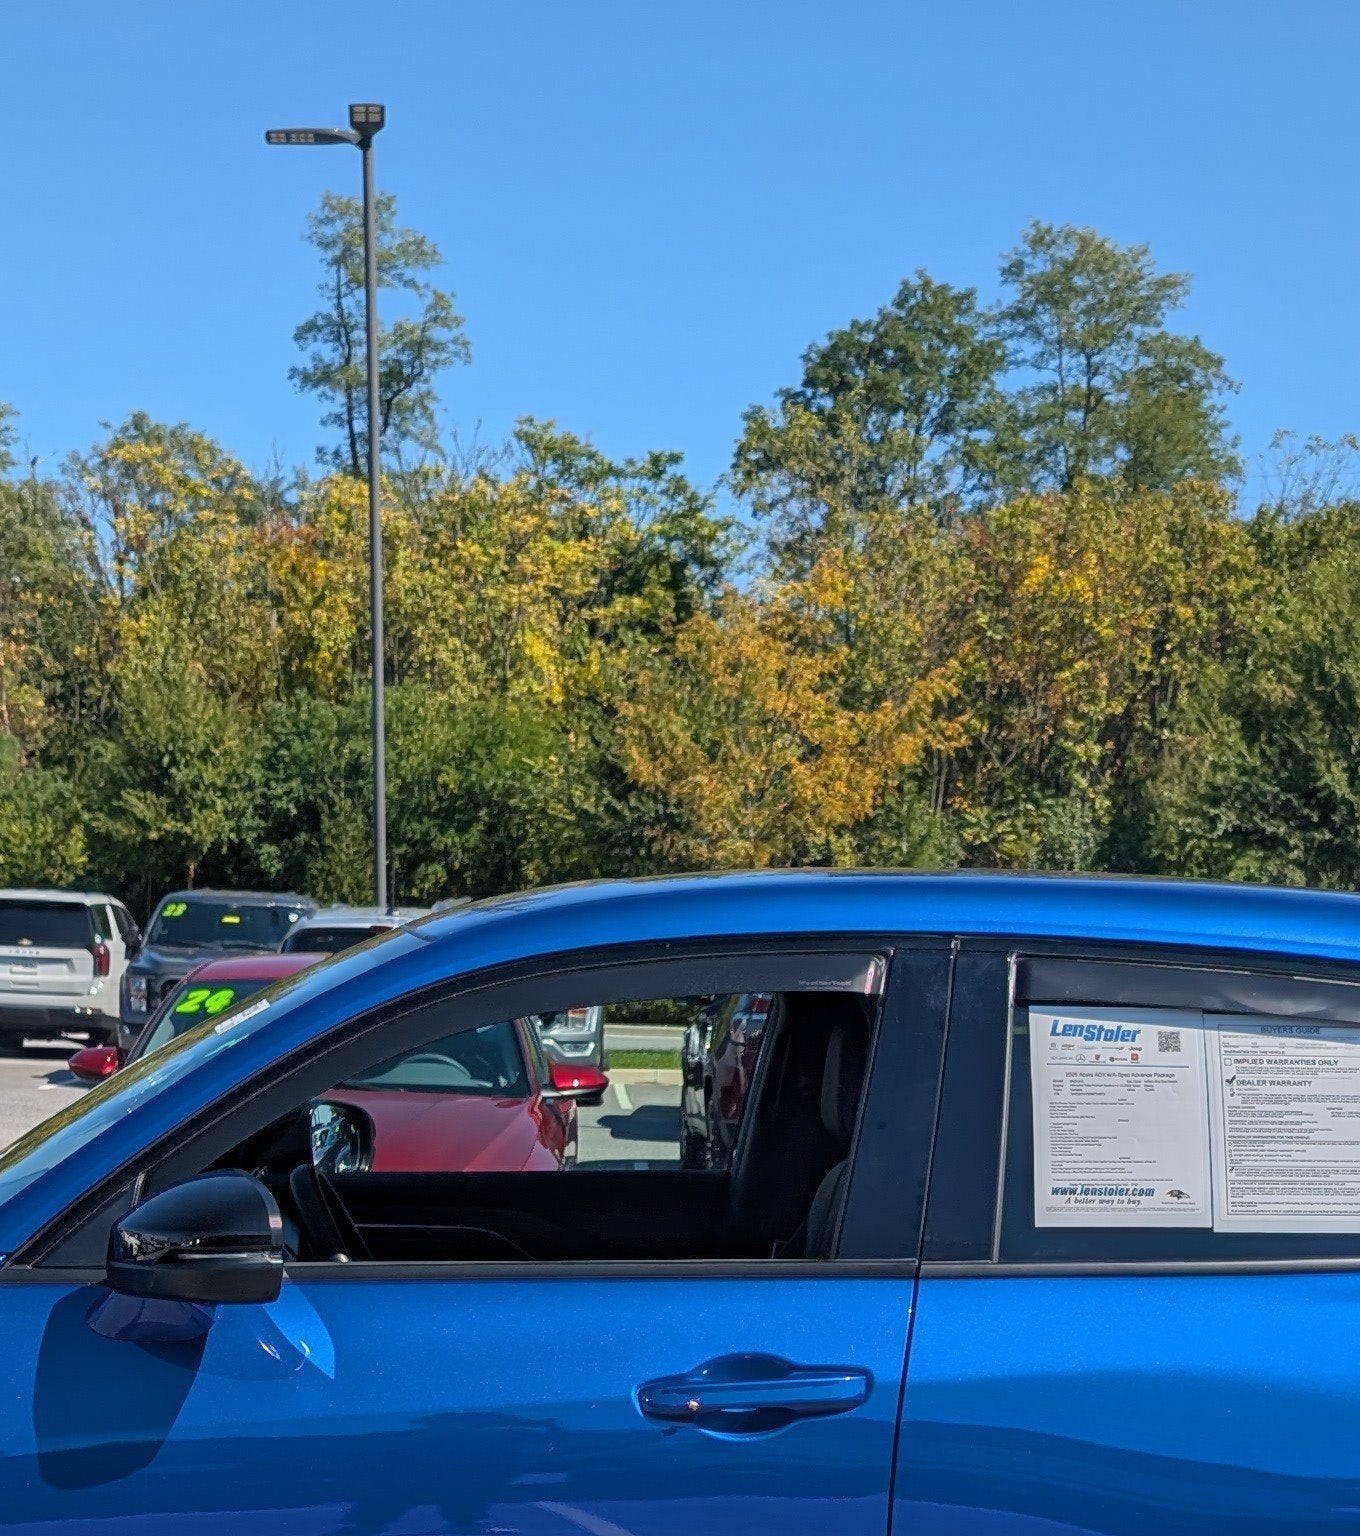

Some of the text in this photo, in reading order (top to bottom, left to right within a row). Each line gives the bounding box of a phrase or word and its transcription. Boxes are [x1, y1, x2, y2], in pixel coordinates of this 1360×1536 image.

[175, 989, 235, 1015] 24
[1233, 1058, 1339, 1067] IMPLIED WARRANTIES ONLY
[1236, 1079, 1313, 1087] DEALER WARRANTY
[1051, 1185, 1156, 1198] www.lenstoler.com
[1073, 1197, 1096, 1205] better
[1098, 1199, 1115, 1207] way
